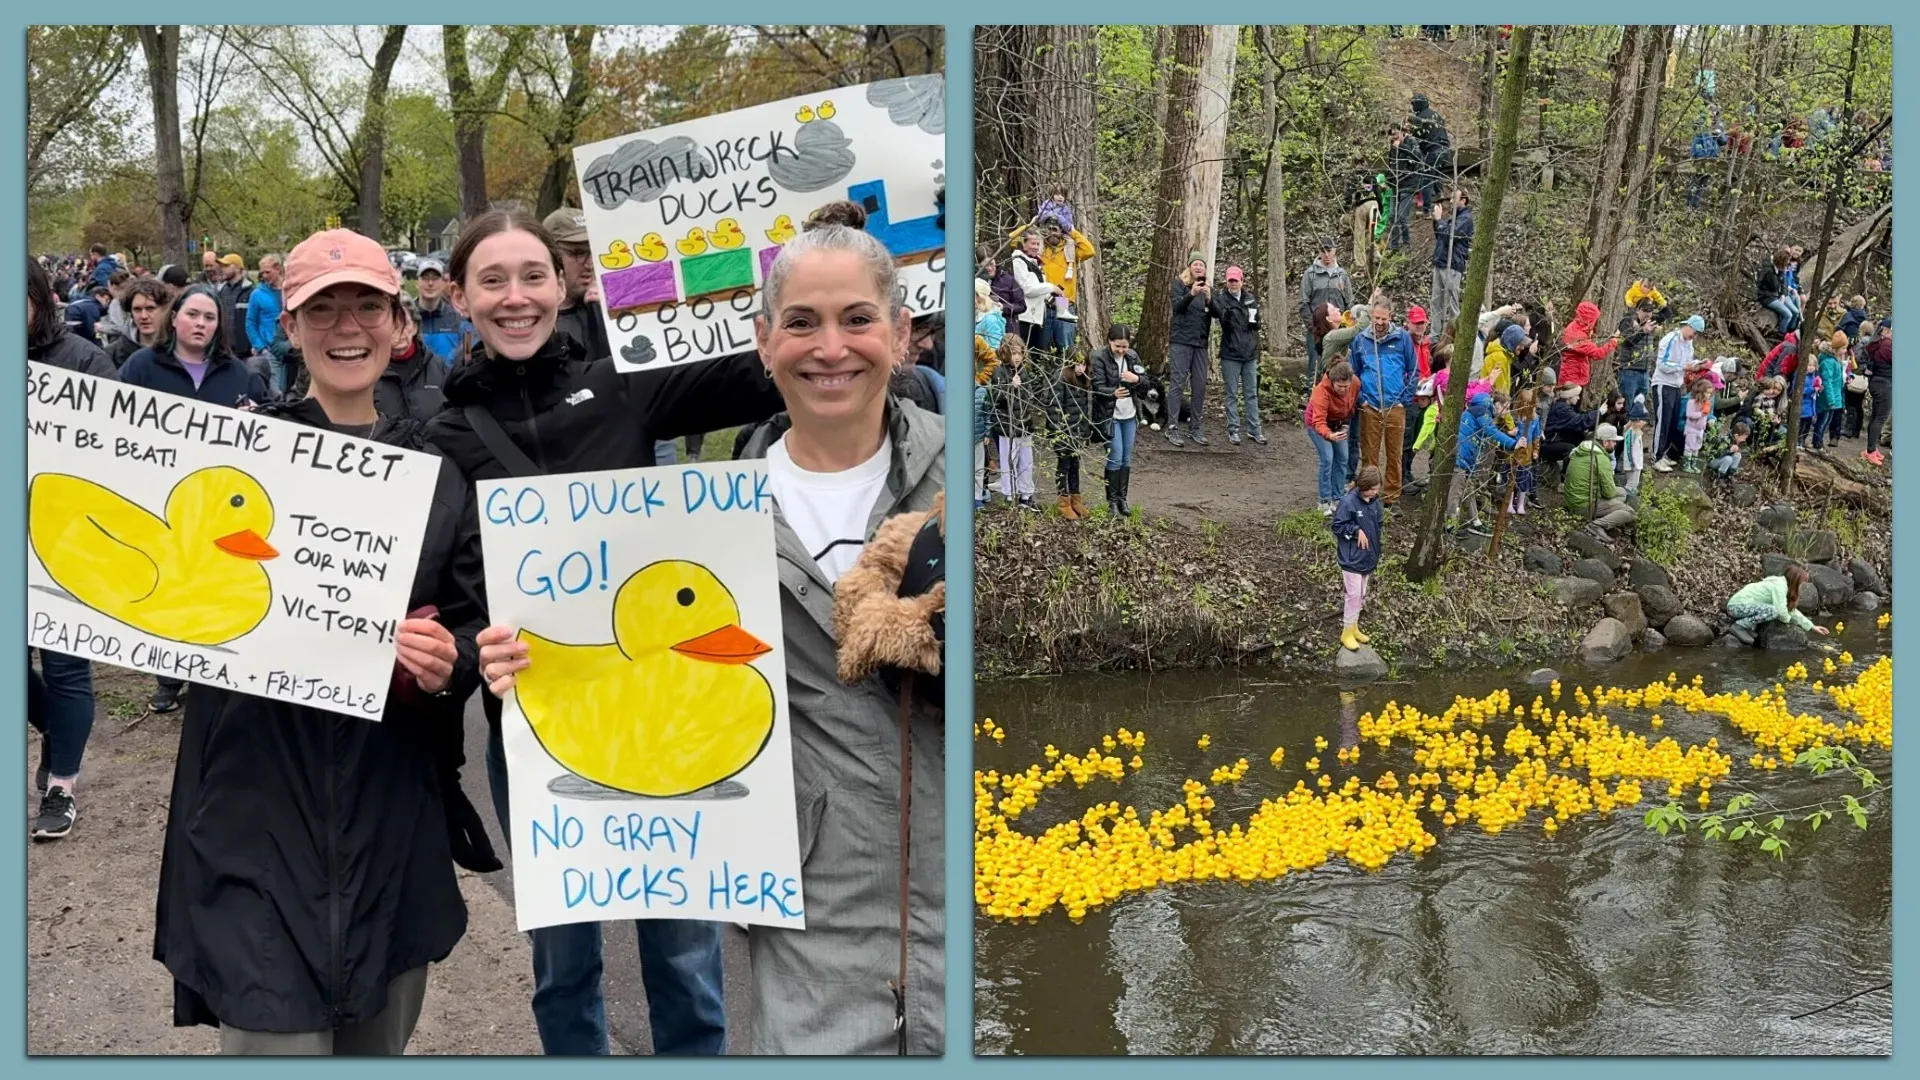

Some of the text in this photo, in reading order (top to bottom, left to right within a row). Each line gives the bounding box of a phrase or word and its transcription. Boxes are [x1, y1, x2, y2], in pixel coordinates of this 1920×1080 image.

[658, 176, 778, 226] DUCKS
[75, 428, 104, 450] BE
[115, 437, 177, 468] BEAT!
[109, 388, 271, 452] MACHINE
[290, 431, 404, 482] FLEET
[485, 486, 549, 527] GO,
[568, 477, 664, 523] DUCK
[290, 513, 399, 555] TOOTIN'
[294, 546, 387, 583] OUR WAY
[516, 540, 609, 602] GO!
[317, 583, 352, 603] TO
[281, 594, 396, 645] VICTORY!
[130, 640, 240, 689] CHICKPEA,
[532, 804, 701, 860] NO GRAY
[563, 861, 804, 918] DUCKS HERE
